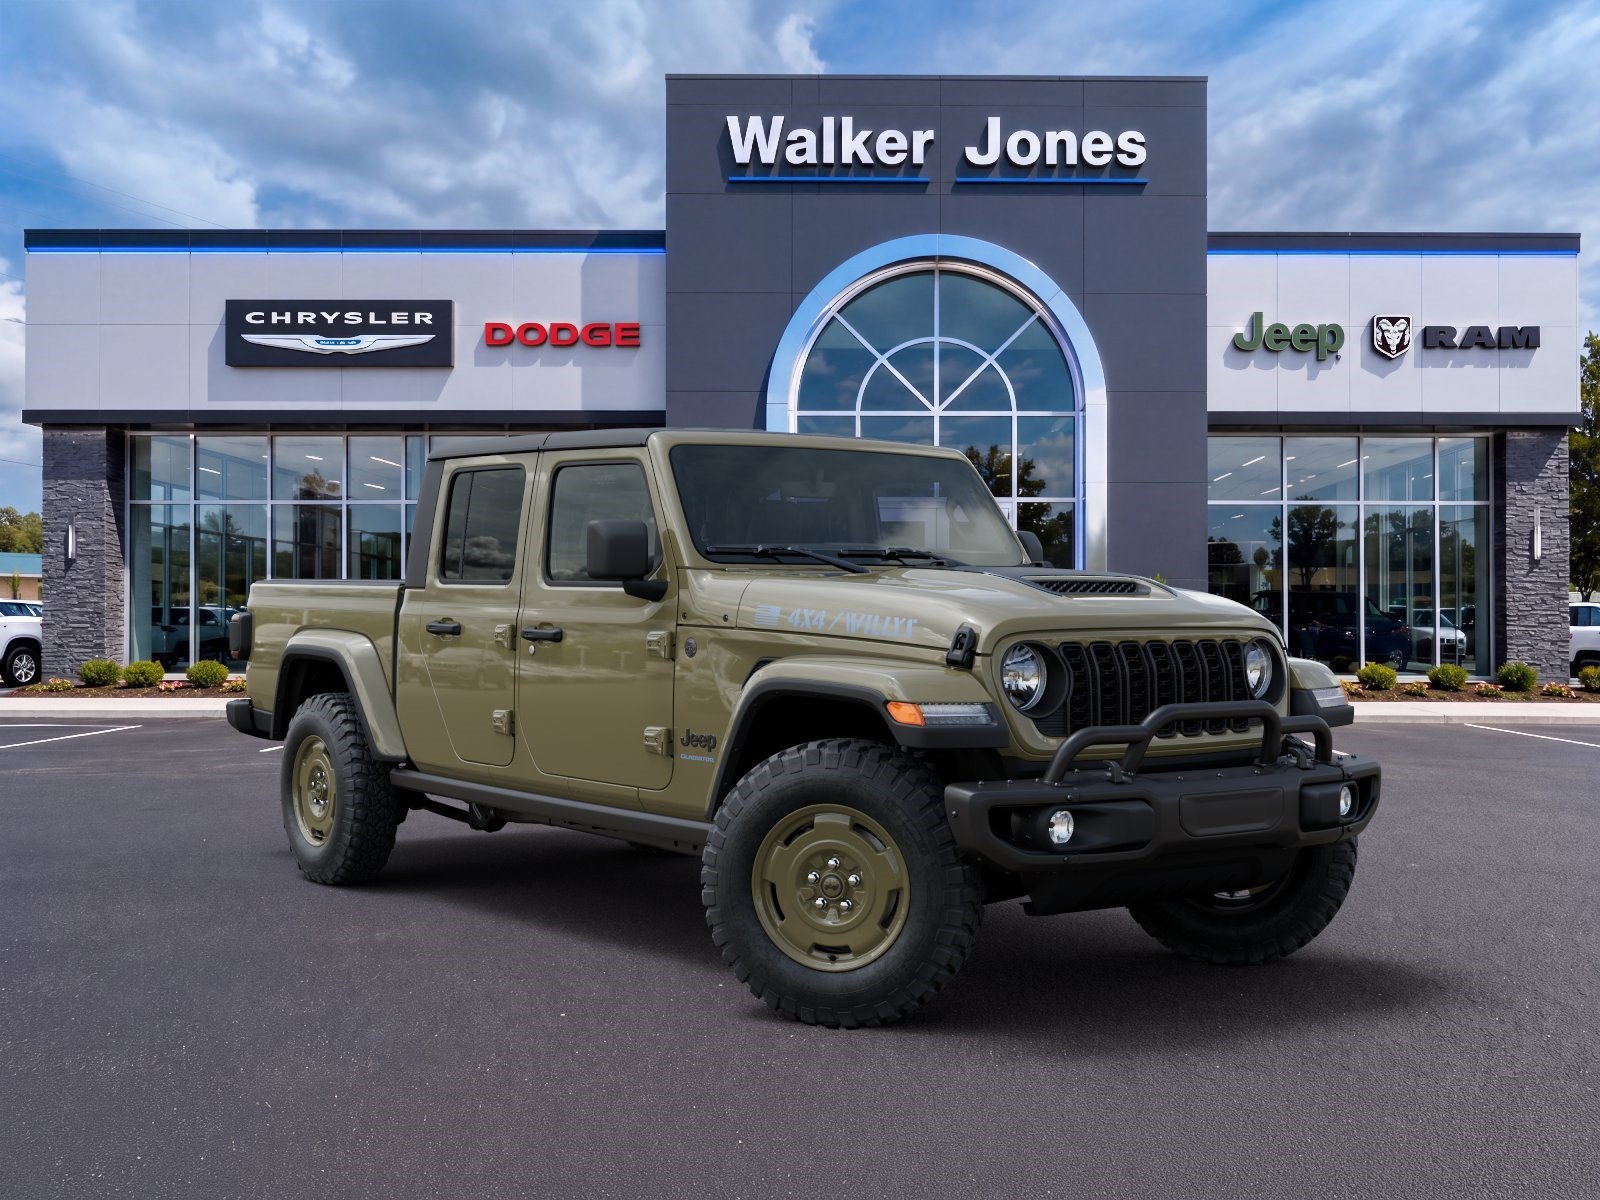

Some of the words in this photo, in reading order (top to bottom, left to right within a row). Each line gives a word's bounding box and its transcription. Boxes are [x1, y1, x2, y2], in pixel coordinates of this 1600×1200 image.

[725, 115, 935, 166] Walker
[964, 115, 1148, 167] Jones
[244, 310, 434, 326] CHRYSLER
[484, 322, 641, 348] DODGE
[1233, 311, 1345, 361] Jeep
[1423, 325, 1541, 349] RAM
[680, 728, 717, 753] Jeep
